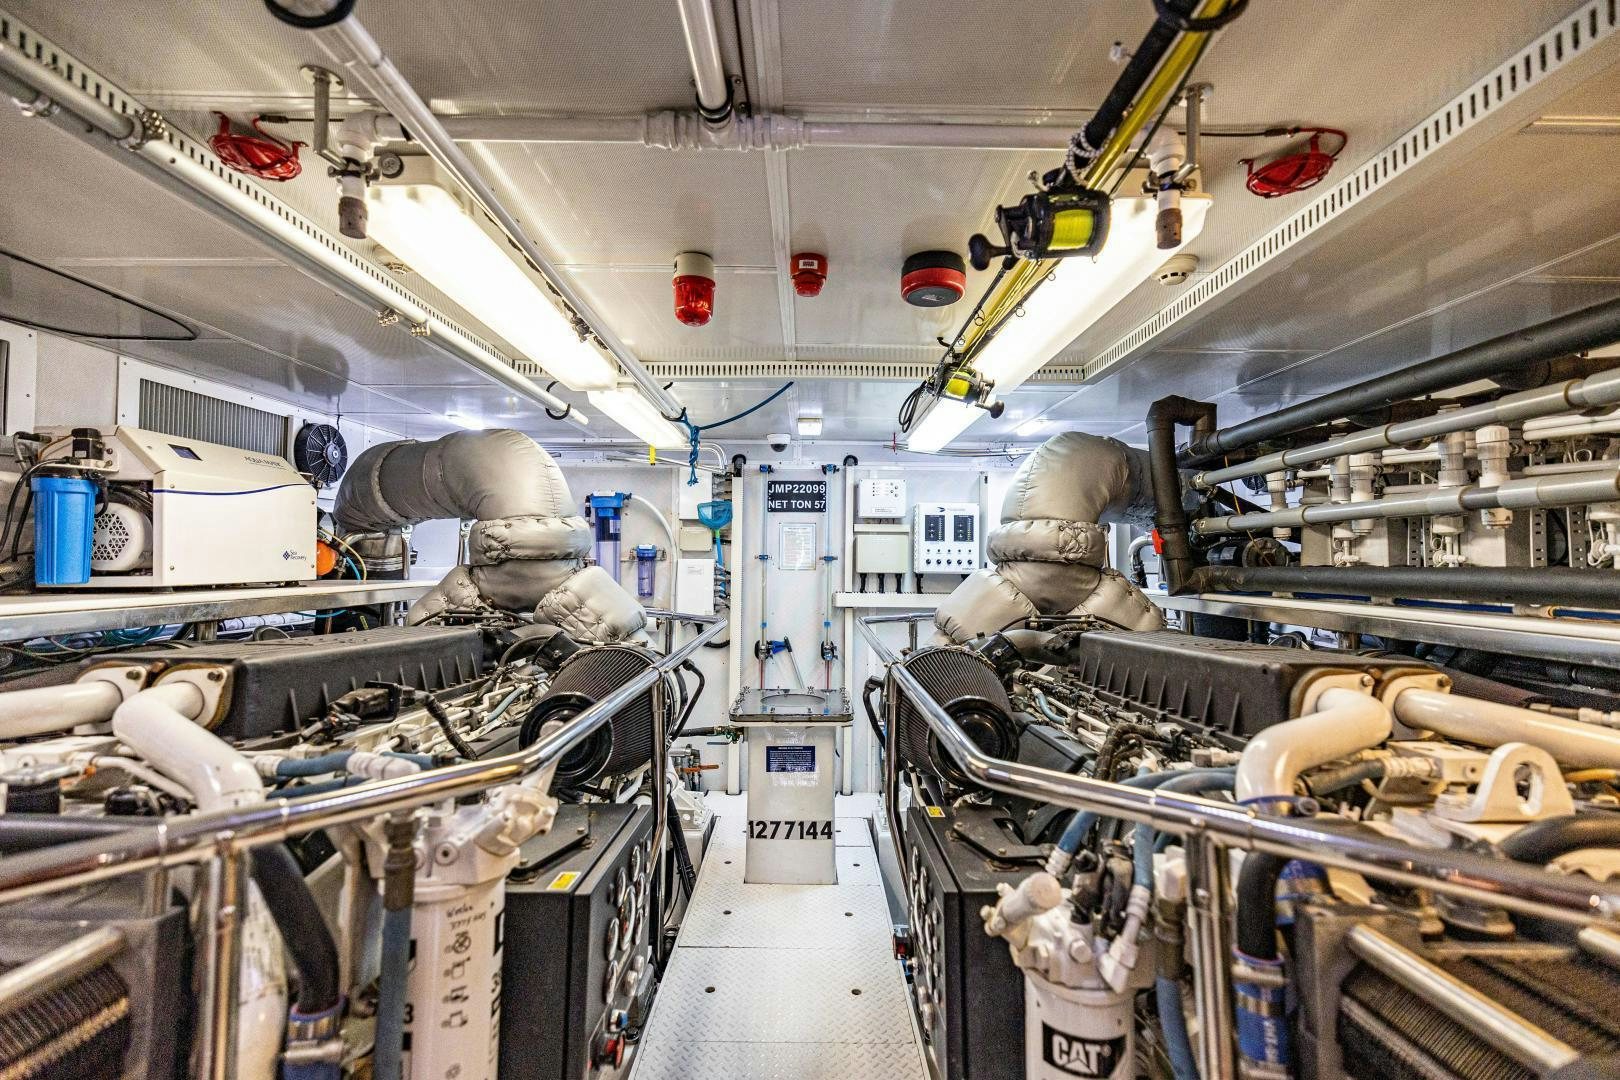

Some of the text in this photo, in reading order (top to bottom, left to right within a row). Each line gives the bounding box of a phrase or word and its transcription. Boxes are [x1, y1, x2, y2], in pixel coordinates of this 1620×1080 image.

[768, 484, 826, 494] JMP22099
[768, 500, 826, 509] NET TON 57
[748, 820, 833, 840] 1277144
[1052, 1033, 1102, 1076] CAT
